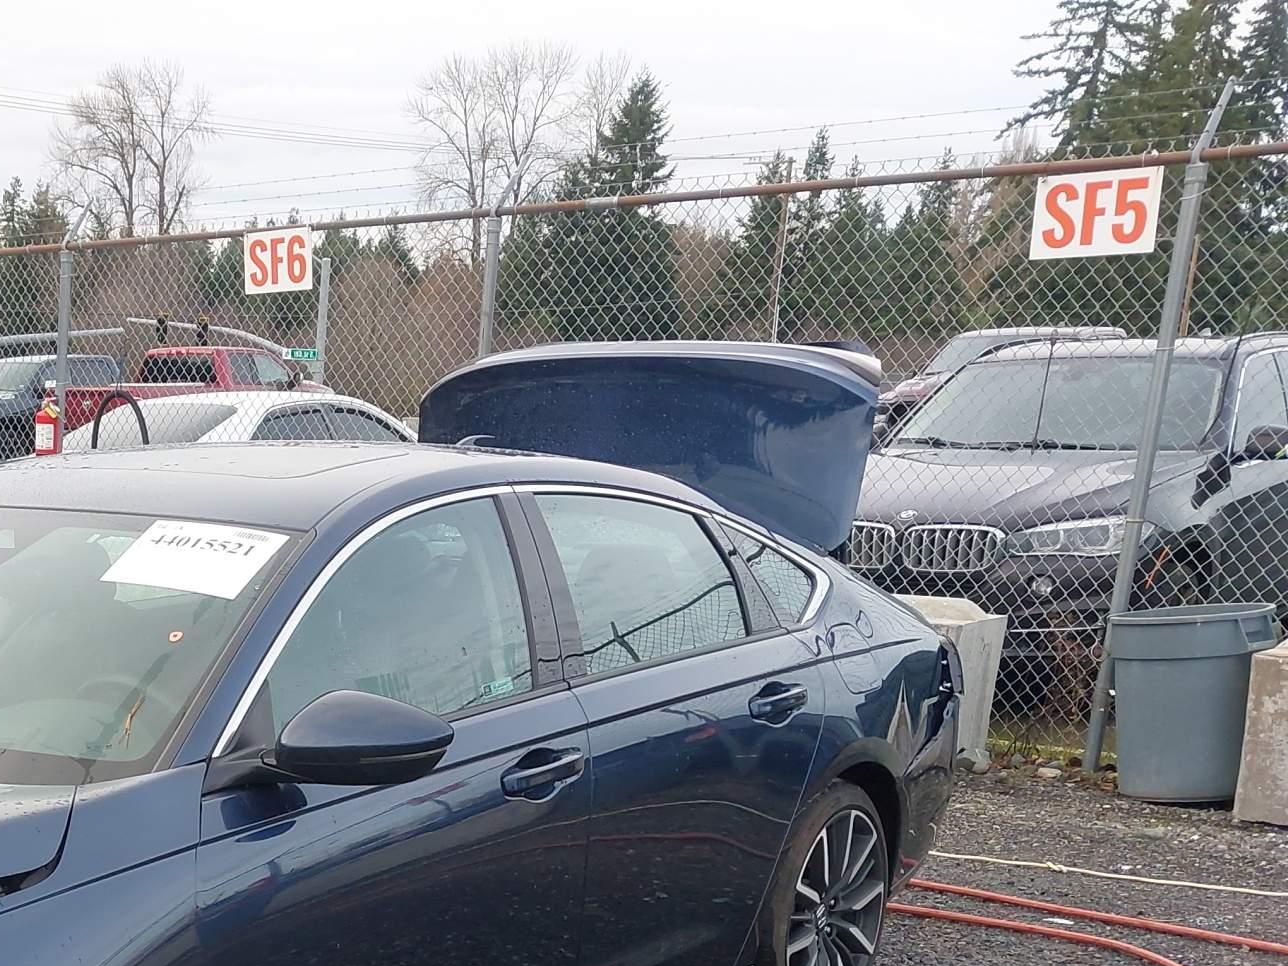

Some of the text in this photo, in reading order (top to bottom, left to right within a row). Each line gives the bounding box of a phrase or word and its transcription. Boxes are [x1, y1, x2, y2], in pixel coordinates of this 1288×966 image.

[1042, 177, 1150, 249] SF5
[250, 235, 307, 287] SF6
[150, 533, 257, 557] 44015521
